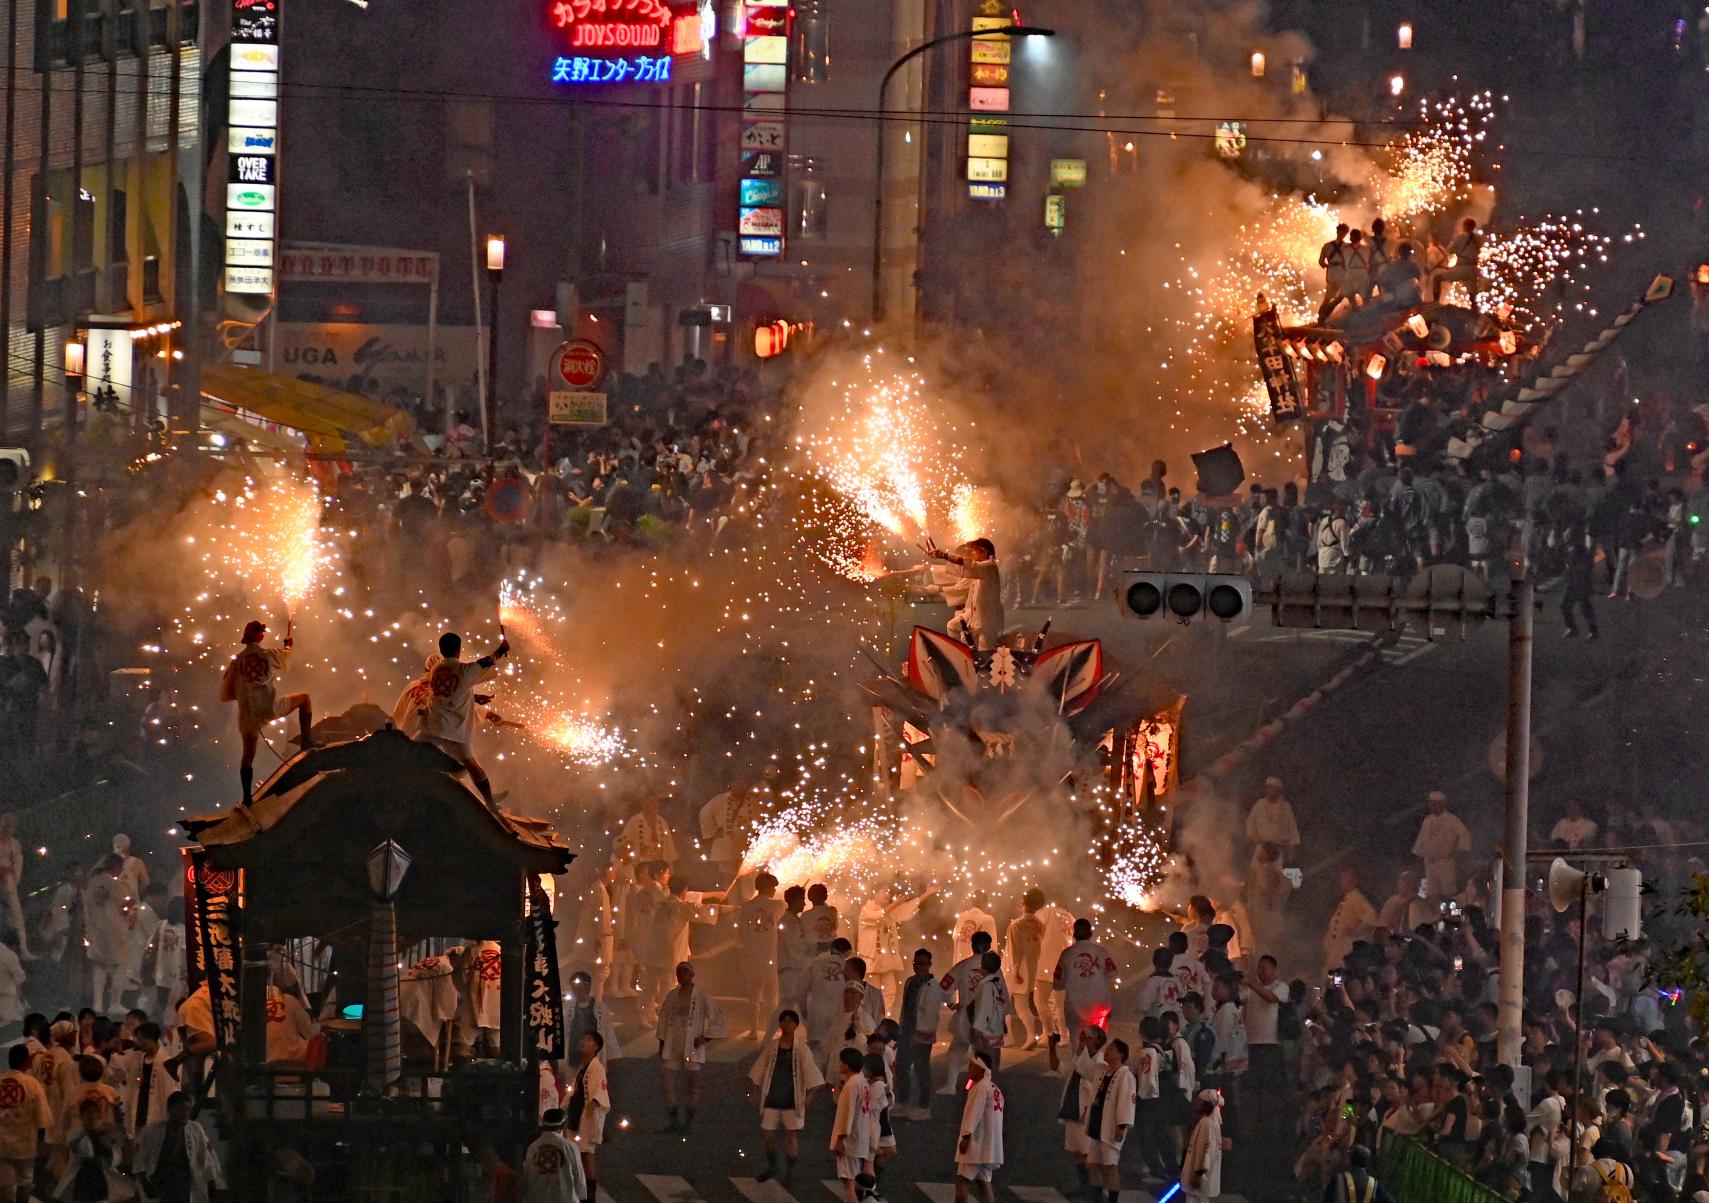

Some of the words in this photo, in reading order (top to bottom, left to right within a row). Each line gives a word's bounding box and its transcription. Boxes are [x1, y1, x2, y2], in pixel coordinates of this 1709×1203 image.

[573, 23, 660, 46] JOYSOUND
[237, 156, 267, 169] OVER
[238, 168, 267, 181] TAKE
